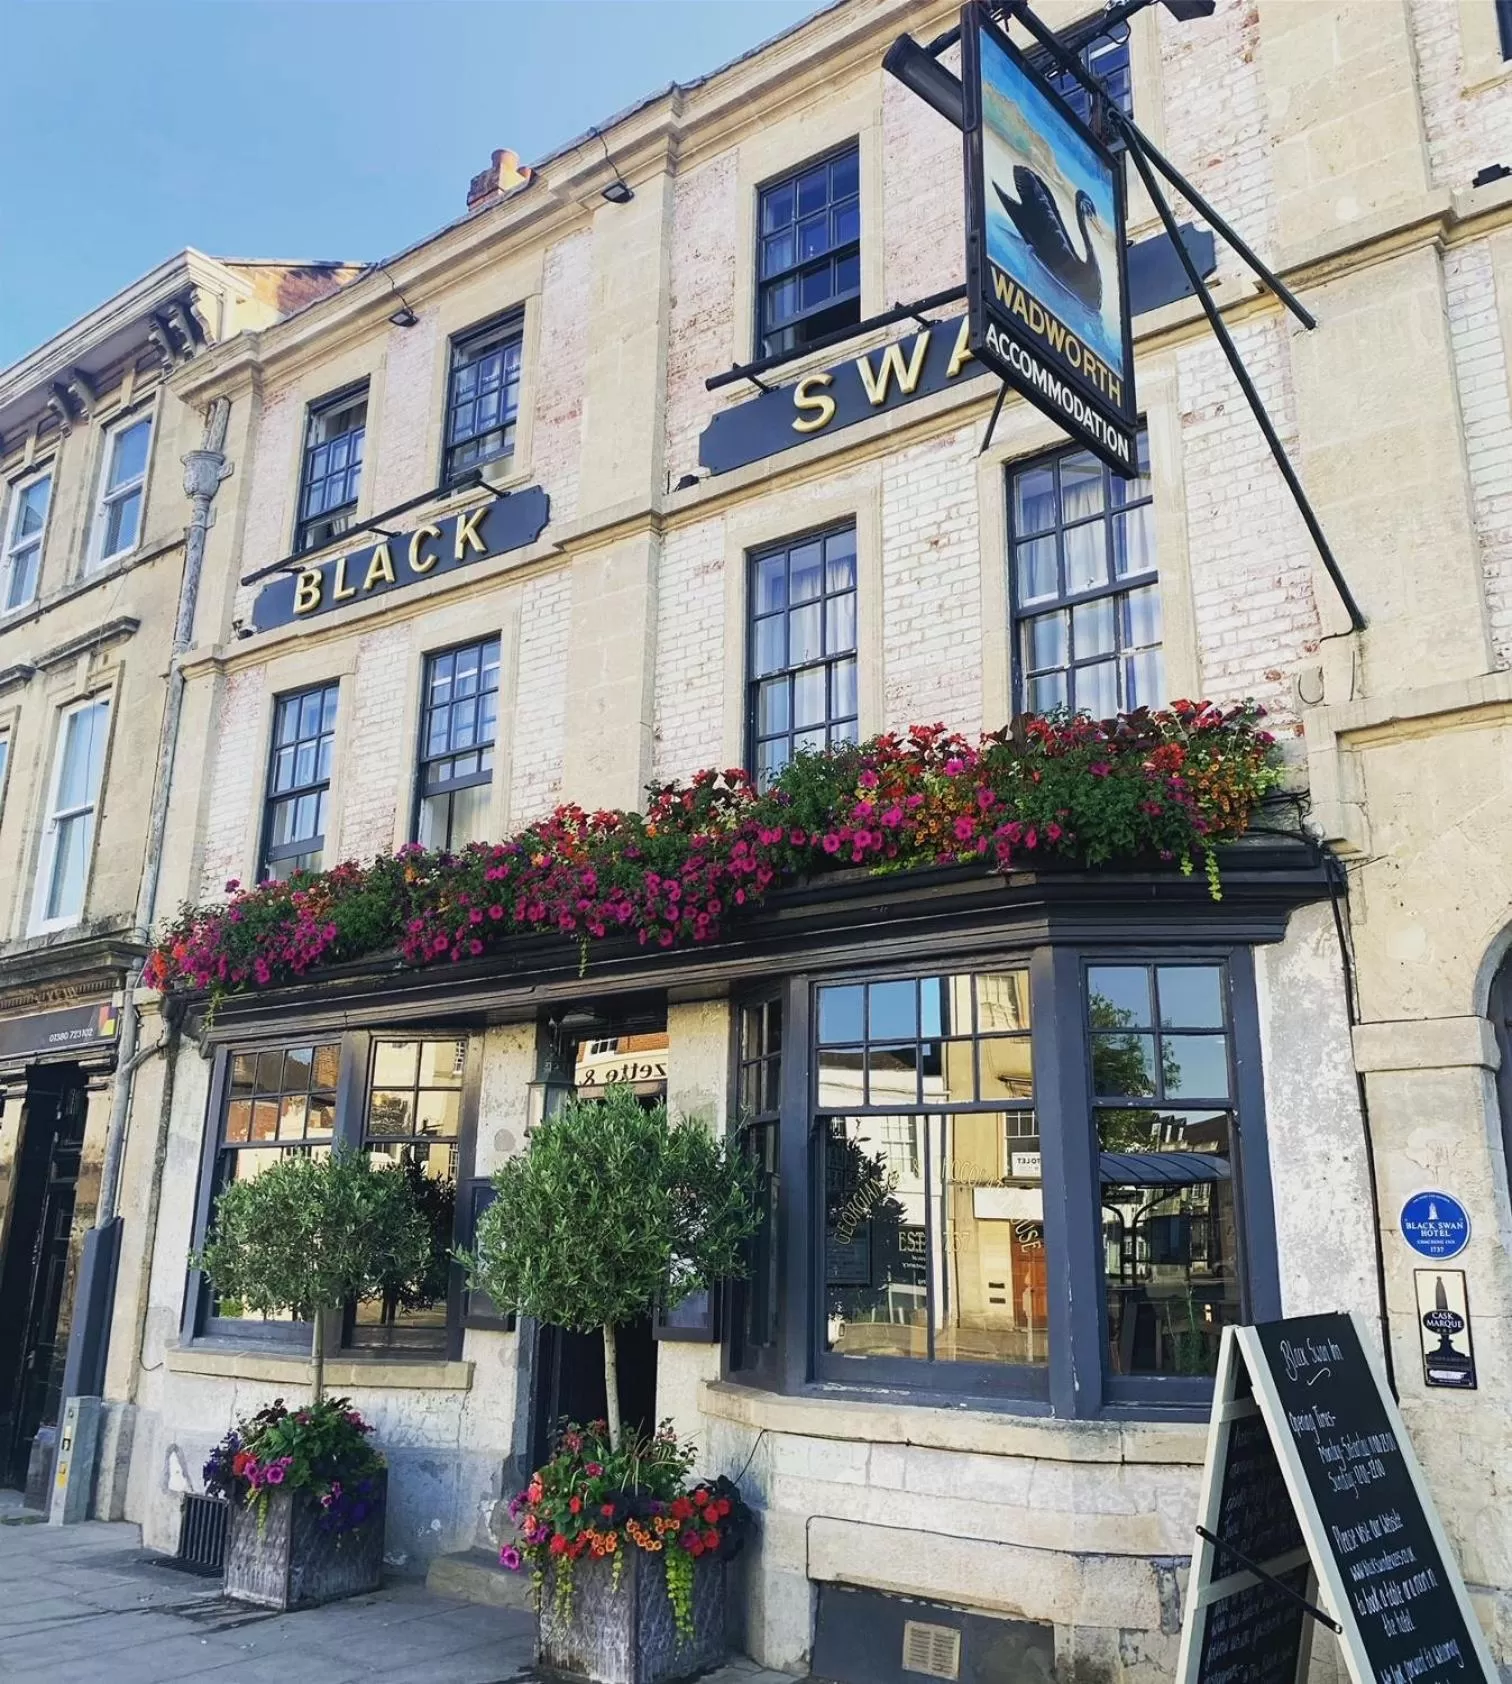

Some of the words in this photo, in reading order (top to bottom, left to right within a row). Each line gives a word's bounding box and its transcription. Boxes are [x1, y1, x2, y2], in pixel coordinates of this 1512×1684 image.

[991, 266, 1121, 408] WADWORTH
[985, 322, 1129, 462] ACCOMMODATION
[293, 506, 488, 614] BLACK
[1405, 1222, 1435, 1230] BLACK
[1437, 1222, 1464, 1230] SWAN
[1426, 1319, 1462, 1328] MARQUE
[1432, 1312, 1454, 1320] CASK
